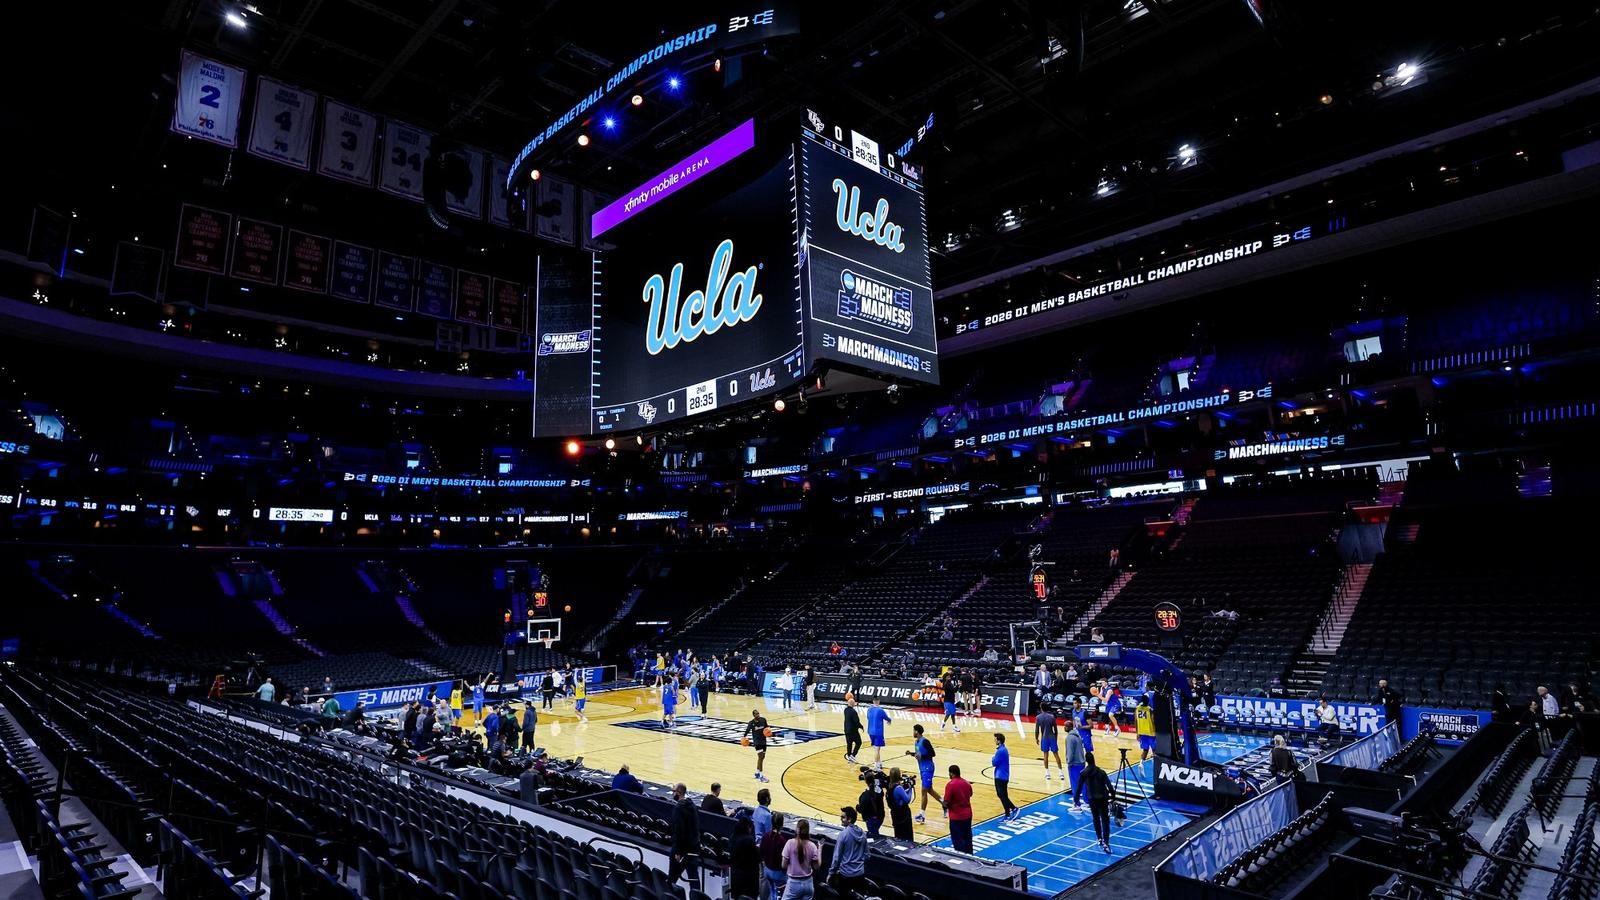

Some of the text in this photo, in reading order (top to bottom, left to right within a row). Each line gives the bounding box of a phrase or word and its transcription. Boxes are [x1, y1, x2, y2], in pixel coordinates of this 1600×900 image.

[545, 86, 604, 140] BASKETBALL
[605, 24, 718, 91] CHAMPIONSHIP
[200, 85, 221, 109] 2
[275, 111, 292, 131] 4
[341, 131, 357, 151] 3
[834, 125, 843, 142] 0
[391, 147, 421, 171] 34
[855, 145, 878, 166] 28:35
[887, 153, 896, 169] 0
[624, 157, 710, 213] xfinity mobile ARENA
[832, 178, 906, 253] Ucla
[854, 277, 894, 306] MARCH
[984, 240, 1263, 327] 2026 DI MEN'S BASKETBALL CHAMPIONSHIP
[642, 238, 763, 356] Ucla
[860, 296, 912, 328] MADNESS
[551, 334, 578, 344] MARCH
[553, 341, 590, 352] MADNESS
[837, 335, 922, 371] MARCHMADNESS
[729, 379, 738, 397] 0
[749, 367, 777, 392] Ucla
[666, 398, 676, 414] 0
[689, 392, 715, 410] 28:35
[980, 394, 1231, 444] 2026 DI MEN'S BASKETBALL CHAMPIONSHIP
[1229, 436, 1329, 460] MARCHMADNESS
[372, 474, 567, 488] 2026 DI MEN'S BASKETBALL CHAMPIONSHIP
[751, 465, 801, 478] MARCHMADNESS
[862, 492, 885, 503] FIRST
[893, 488, 924, 499] SECOND
[925, 483, 960, 495] ROUNDS
[218, 508, 231, 517] UCF
[253, 508, 260, 519] 0
[275, 510, 303, 519] 28:35
[626, 511, 681, 521] MARCHMADNESS
[1162, 618, 1176, 629] 30
[380, 687, 424, 705] MARCH
[831, 682, 848, 694] THE
[876, 686, 890, 697] TO
[892, 687, 912, 699] THE
[1430, 714, 1462, 724] MARCH
[1435, 723, 1478, 733] MADNESS
[1159, 762, 1214, 791] NCAA
